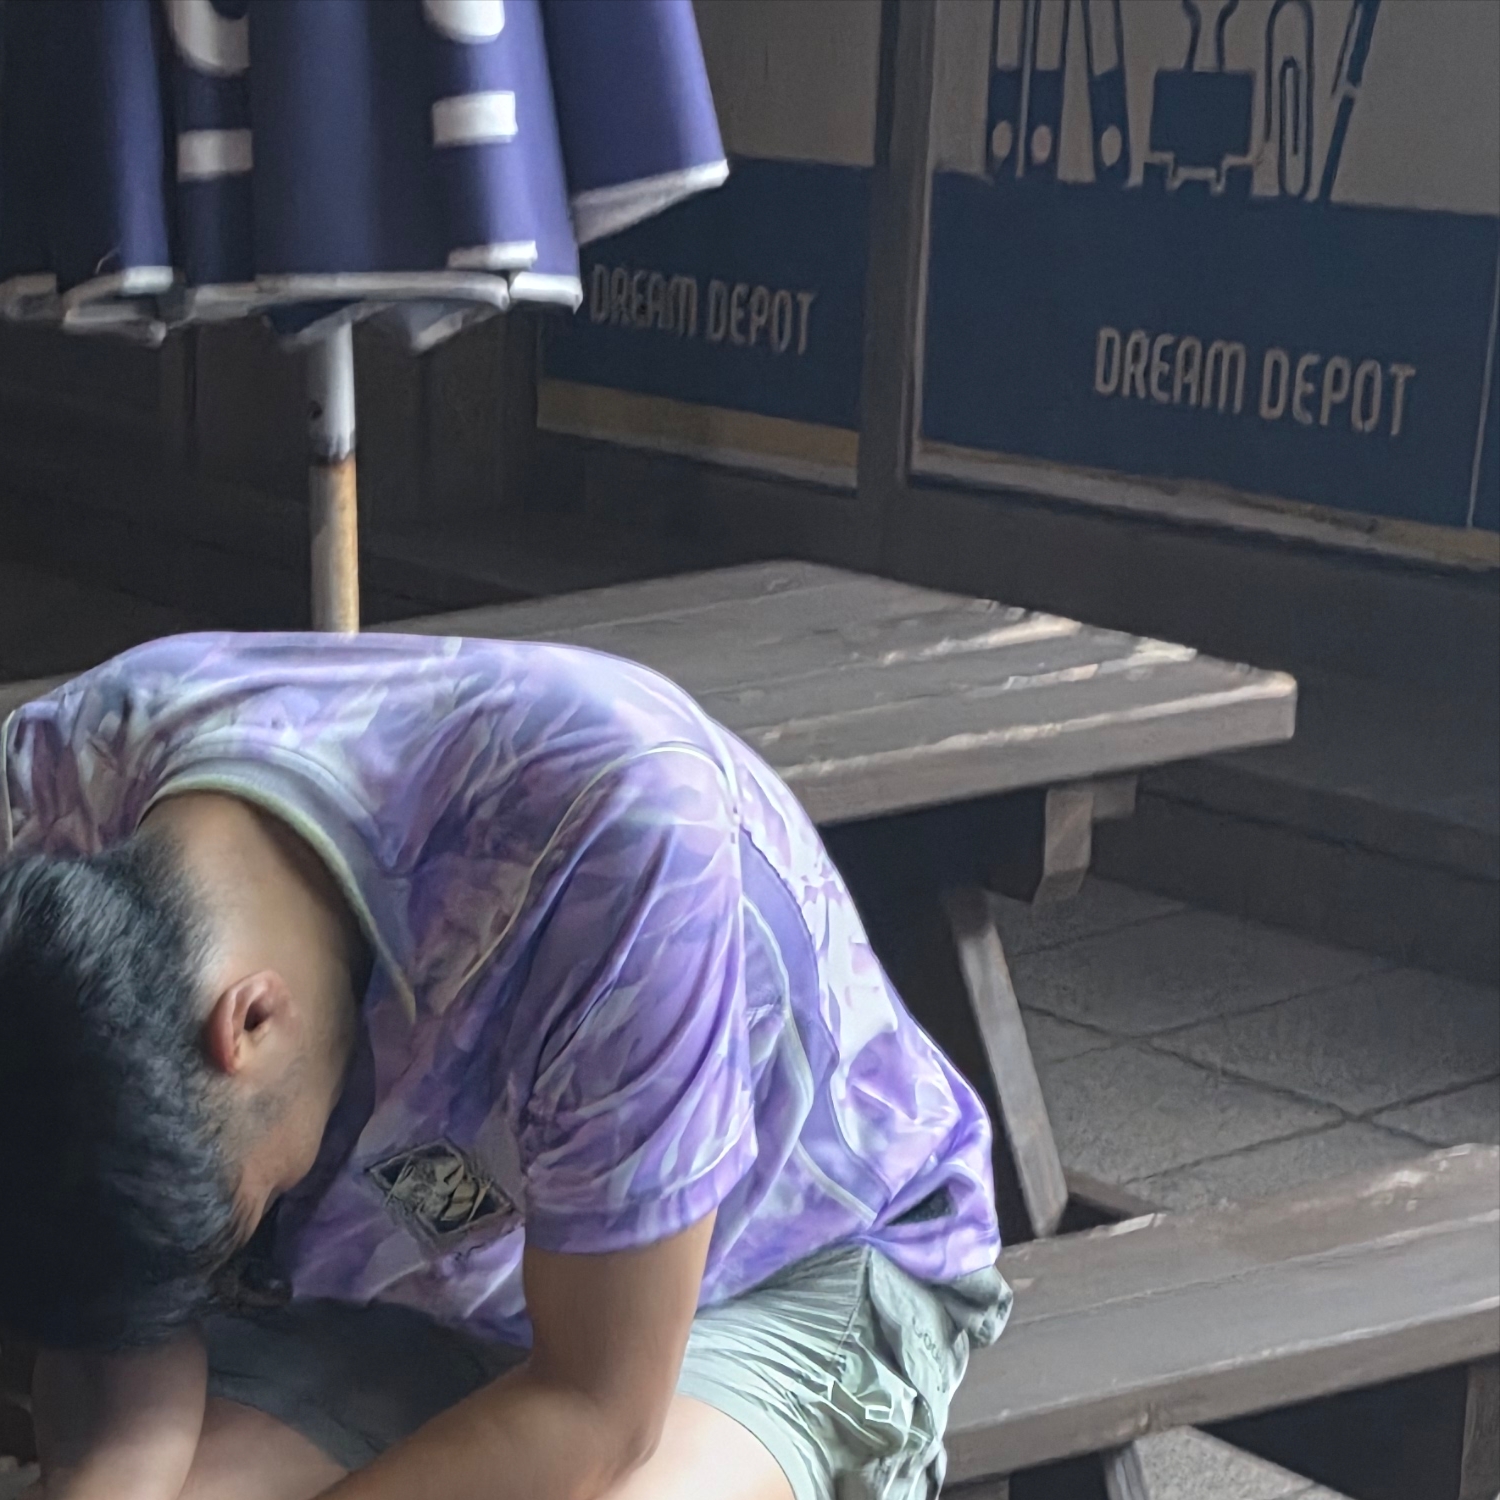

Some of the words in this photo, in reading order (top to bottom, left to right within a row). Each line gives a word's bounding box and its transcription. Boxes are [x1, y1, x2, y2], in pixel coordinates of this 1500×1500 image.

[589, 263, 699, 338] DREAM
[706, 279, 818, 356] DEPOT
[1094, 326, 1247, 415] DREAM
[1258, 346, 1417, 437] DEPOT
